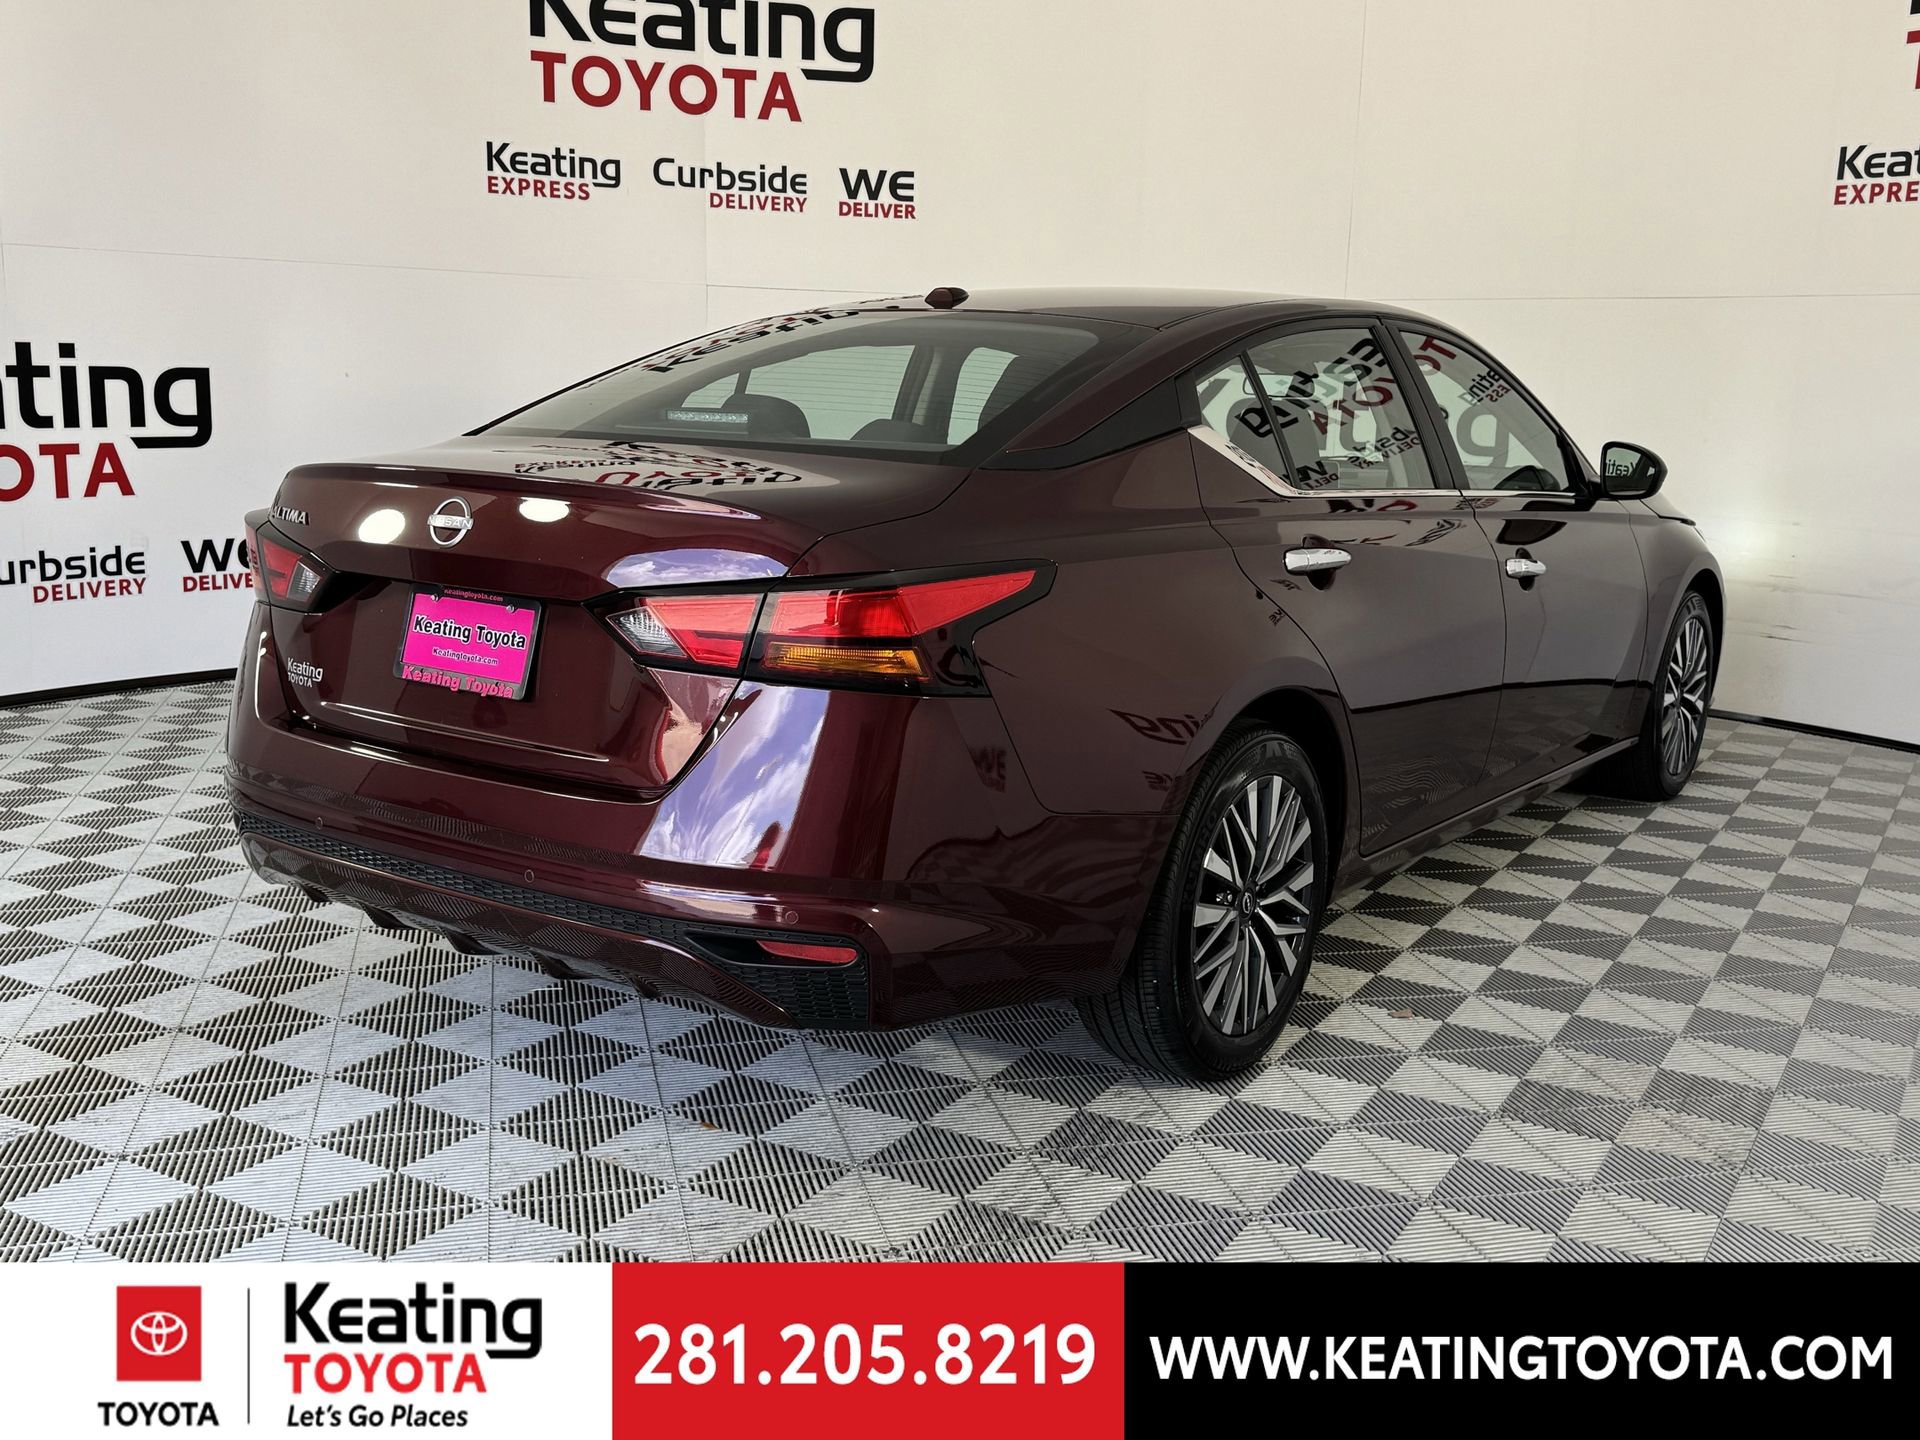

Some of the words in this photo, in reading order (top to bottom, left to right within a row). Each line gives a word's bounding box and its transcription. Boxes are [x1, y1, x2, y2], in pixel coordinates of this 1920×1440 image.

[530, 0, 875, 83] Keating
[530, 50, 802, 122] TOYOTA
[486, 141, 621, 188] Keating
[652, 158, 807, 195] Curbside
[487, 176, 590, 201] EXPRESS
[709, 192, 807, 213] DELIVERY
[838, 201, 916, 220] DELIVER
[271, 505, 310, 526] ALTIMA
[33, 577, 146, 604] DELIVERY
[412, 614, 472, 644] Keating
[475, 623, 527, 650] Toyota
[287, 657, 323, 682] Keating
[287, 671, 313, 688] TOYOTA
[401, 665, 461, 692] Keating
[465, 676, 515, 699] Toyota
